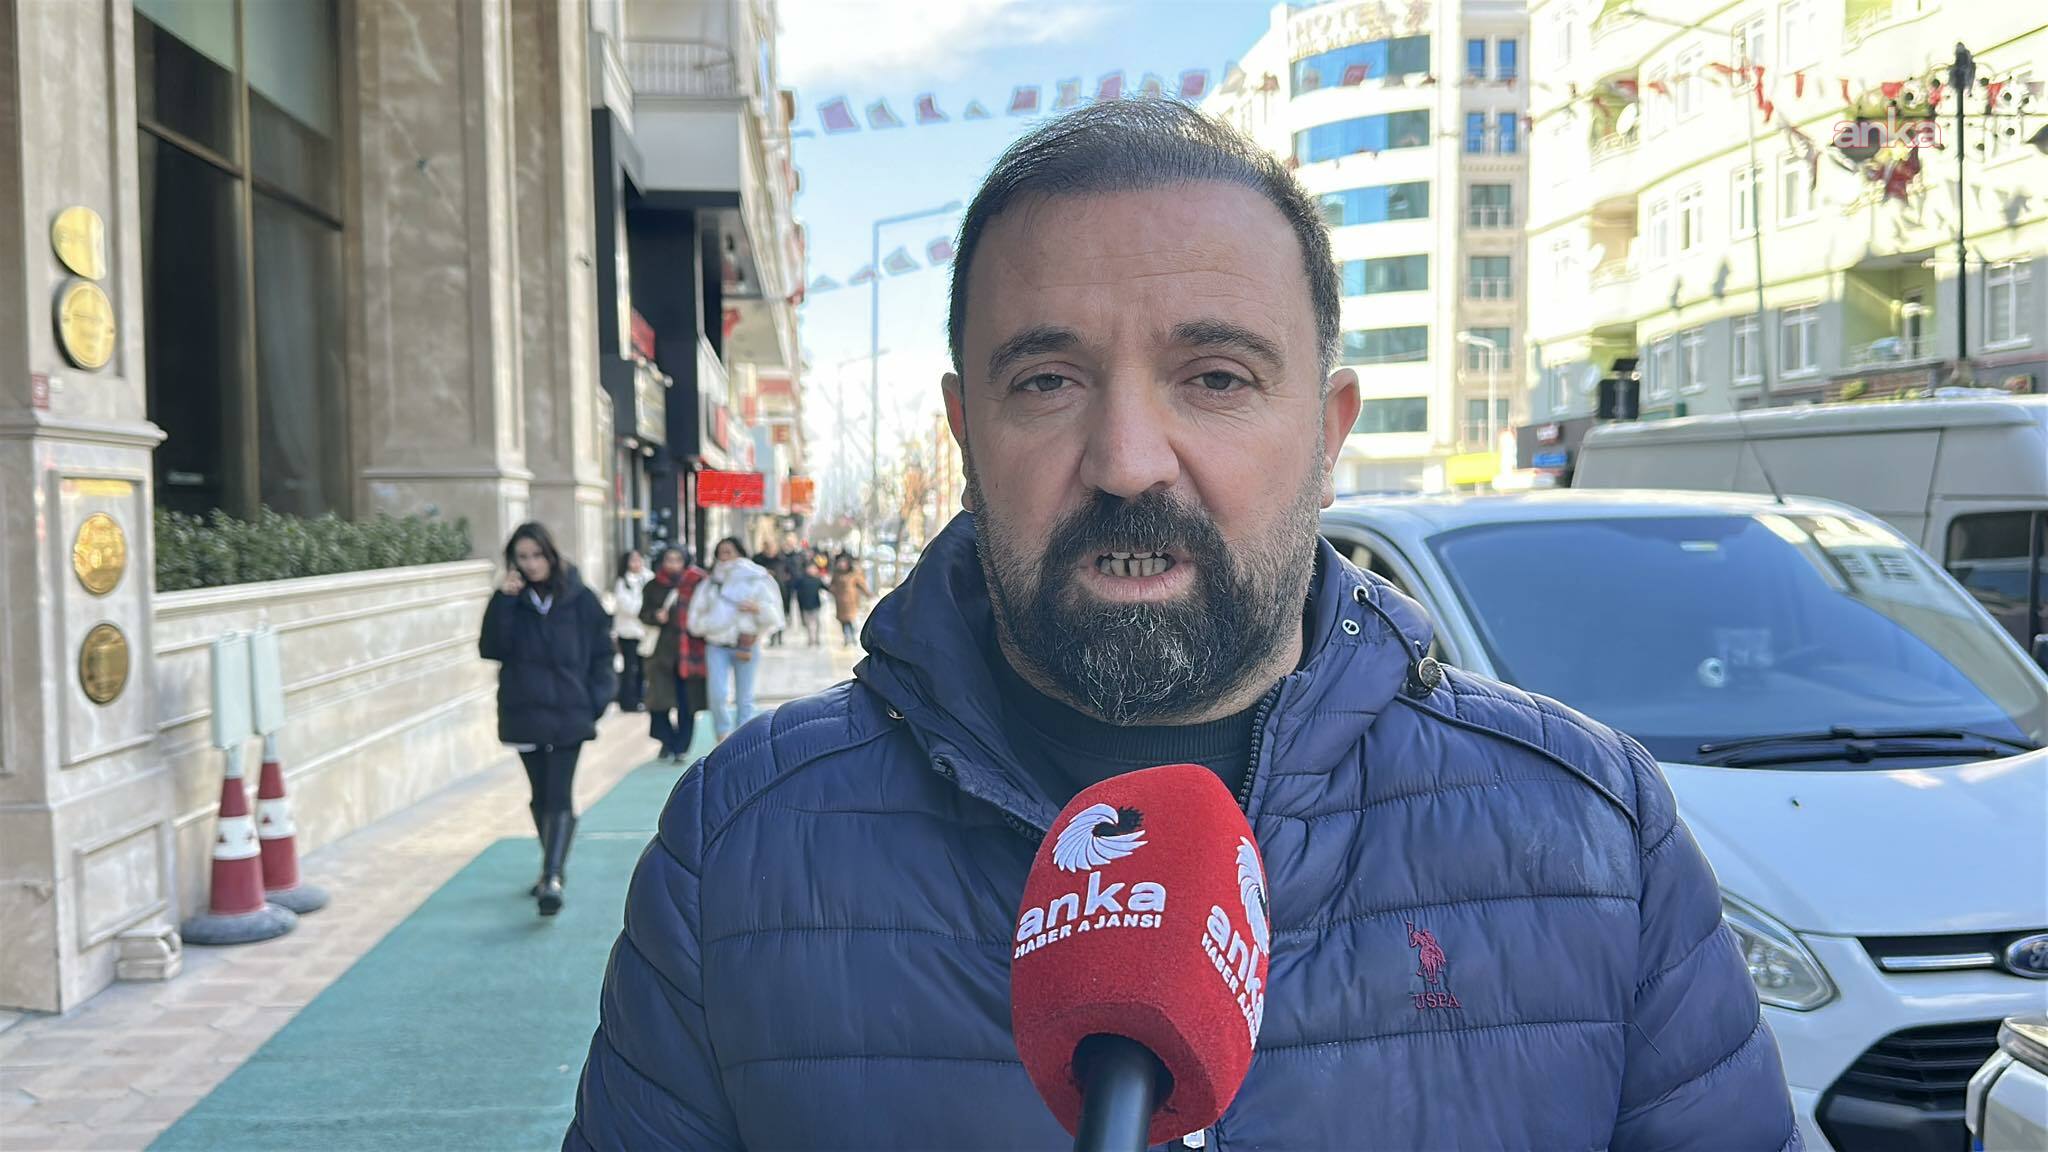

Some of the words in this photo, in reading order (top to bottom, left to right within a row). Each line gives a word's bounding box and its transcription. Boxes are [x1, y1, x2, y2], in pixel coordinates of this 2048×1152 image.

[1016, 871, 1167, 942] anka
[1014, 924, 1072, 959] HABER
[1077, 914, 1162, 932] AJANSI
[1201, 932, 1239, 995] HABER
[1409, 992, 1462, 1010] USPA
